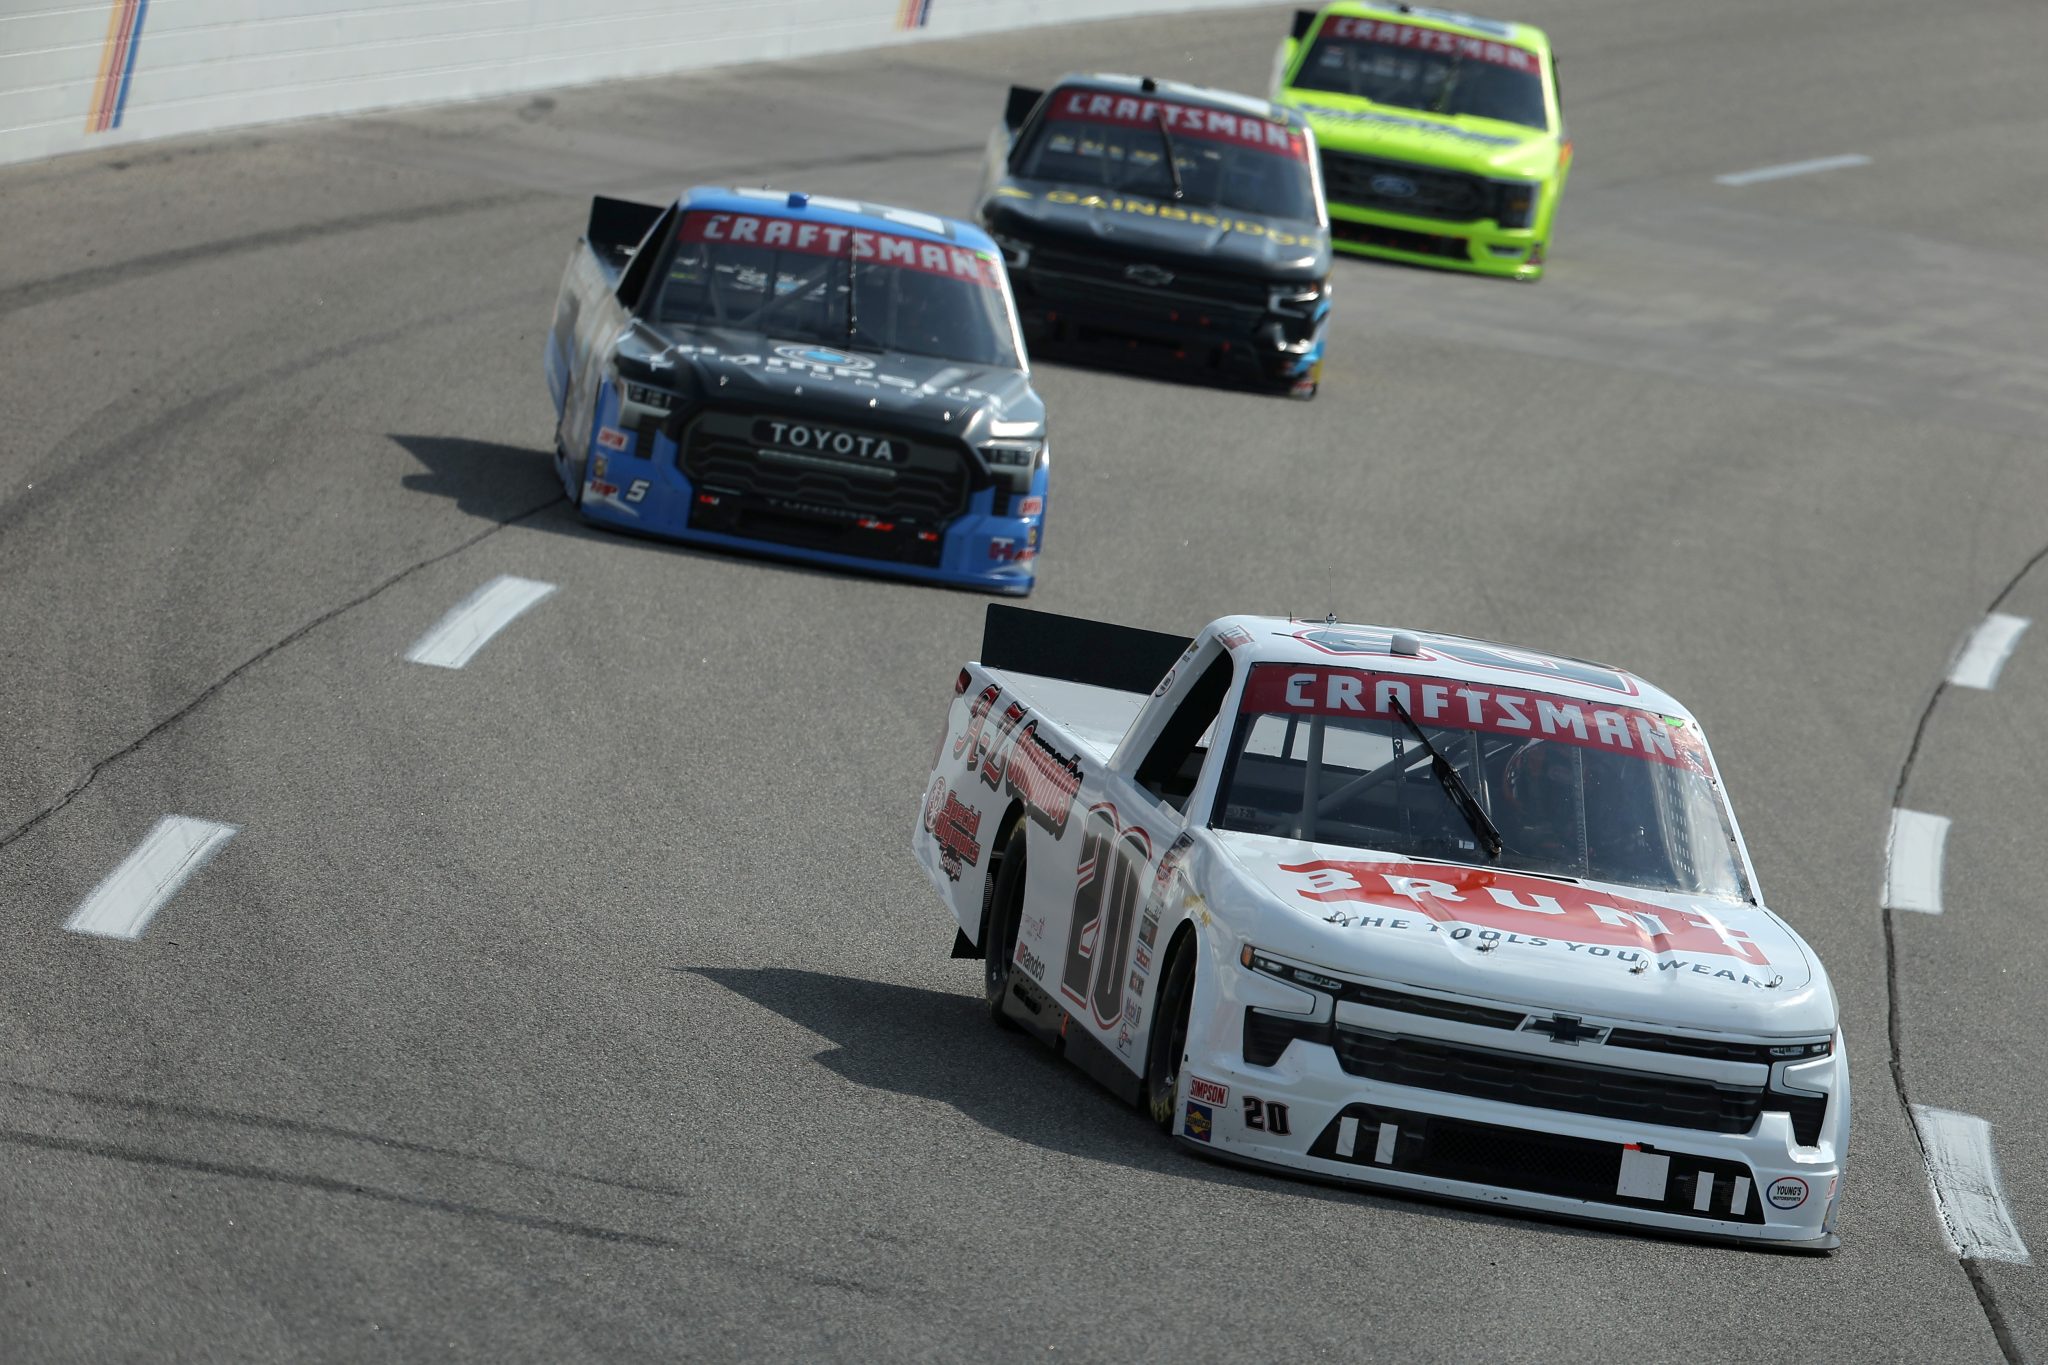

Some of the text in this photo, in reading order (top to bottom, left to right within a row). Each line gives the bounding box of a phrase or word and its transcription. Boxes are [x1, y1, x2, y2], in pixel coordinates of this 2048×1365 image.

[1334, 18, 1530, 69] CRAFTSMAN
[1067, 94, 1290, 149] CRAFTSMAN
[702, 214, 979, 279] CRAFTSMAN
[769, 422, 893, 462] TOYOTA
[625, 478, 651, 502] 5
[953, 684, 1029, 790] A-Z
[1285, 672, 1677, 759] CRAFTSMAN
[934, 810, 981, 867] Olympics
[944, 789, 981, 837] Special
[940, 851, 962, 877] Georgia
[1061, 801, 1152, 1031] 20
[1306, 868, 1754, 957] BRUNT
[1333, 915, 1766, 989] THE TOOLS YOU WEAR
[1190, 1079, 1226, 1105] SIMPSON
[1242, 1095, 1292, 1137] 20
[1186, 1114, 1211, 1129] SUNOCO
[1776, 1185, 1802, 1196] YOUNG'S
